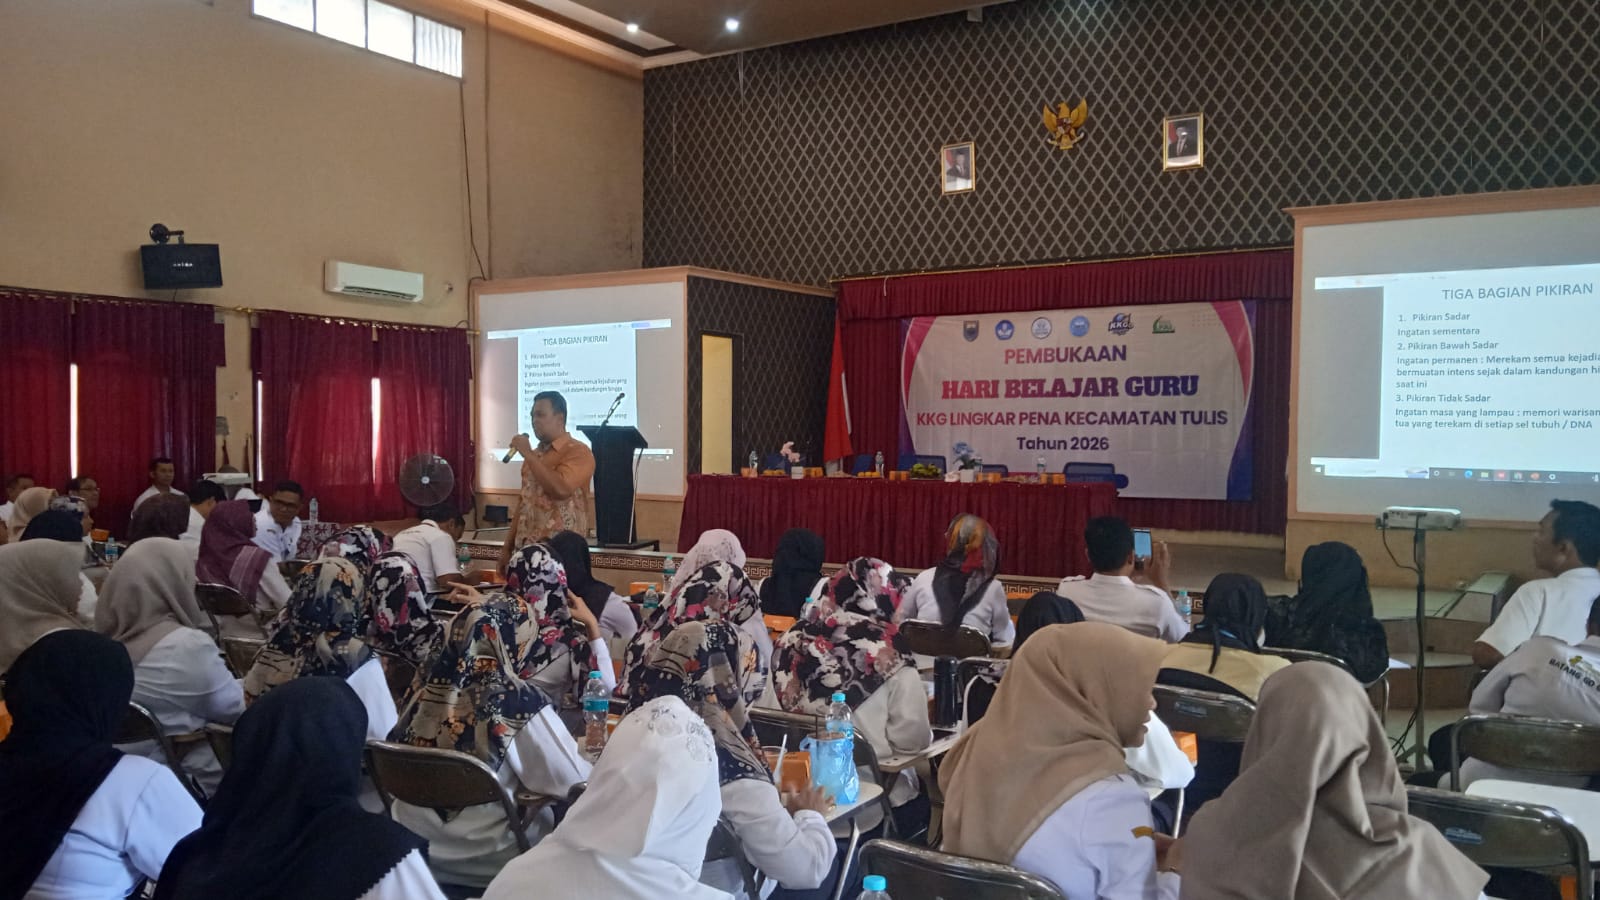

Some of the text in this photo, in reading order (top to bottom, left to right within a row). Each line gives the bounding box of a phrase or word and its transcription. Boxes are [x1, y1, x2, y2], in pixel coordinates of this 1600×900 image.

[1442, 283, 1593, 300] TIGA BAGIAN PIKIRAN
[1413, 313, 1443, 321] Pikiran
[1445, 312, 1470, 320] Sadar
[1398, 327, 1480, 338] Ingatan sementara
[543, 334, 608, 346] TIGA BAGIAN PIKIRAN
[1397, 341, 1499, 351] 2. Pikiran Bawah Sadar
[1004, 345, 1127, 365] PEMBUKAAN
[1397, 357, 1429, 367] Ingatan
[1432, 357, 1478, 366] permanen
[1486, 355, 1531, 364] Merekam
[1533, 354, 1566, 363] semua
[1447, 368, 1475, 376] intens
[1477, 367, 1501, 377] sejak
[1503, 367, 1533, 376] dalam
[1535, 366, 1589, 376] kandungan
[942, 375, 1199, 399] HARI BELAJAR GURU
[1416, 380, 1428, 388] ini
[1406, 394, 1436, 402] Pikiran
[1438, 394, 1463, 402] Tidak
[1464, 394, 1491, 402] Sadar
[916, 410, 1228, 426] KKG LINGKAR PENA KECAMATAN TULIS
[1395, 408, 1428, 418] Ingatan
[1455, 409, 1477, 418] yang
[1479, 408, 1515, 418] lampau
[1522, 408, 1560, 416] memori
[1411, 421, 1433, 429] yang
[1434, 420, 1472, 428] terekam
[1474, 420, 1483, 428] di
[1485, 420, 1514, 430] setiap
[1515, 420, 1529, 428] sel
[1531, 420, 1560, 429] tubuh
[1570, 420, 1593, 429] DNA
[1016, 437, 1110, 450] Tahun 2026
